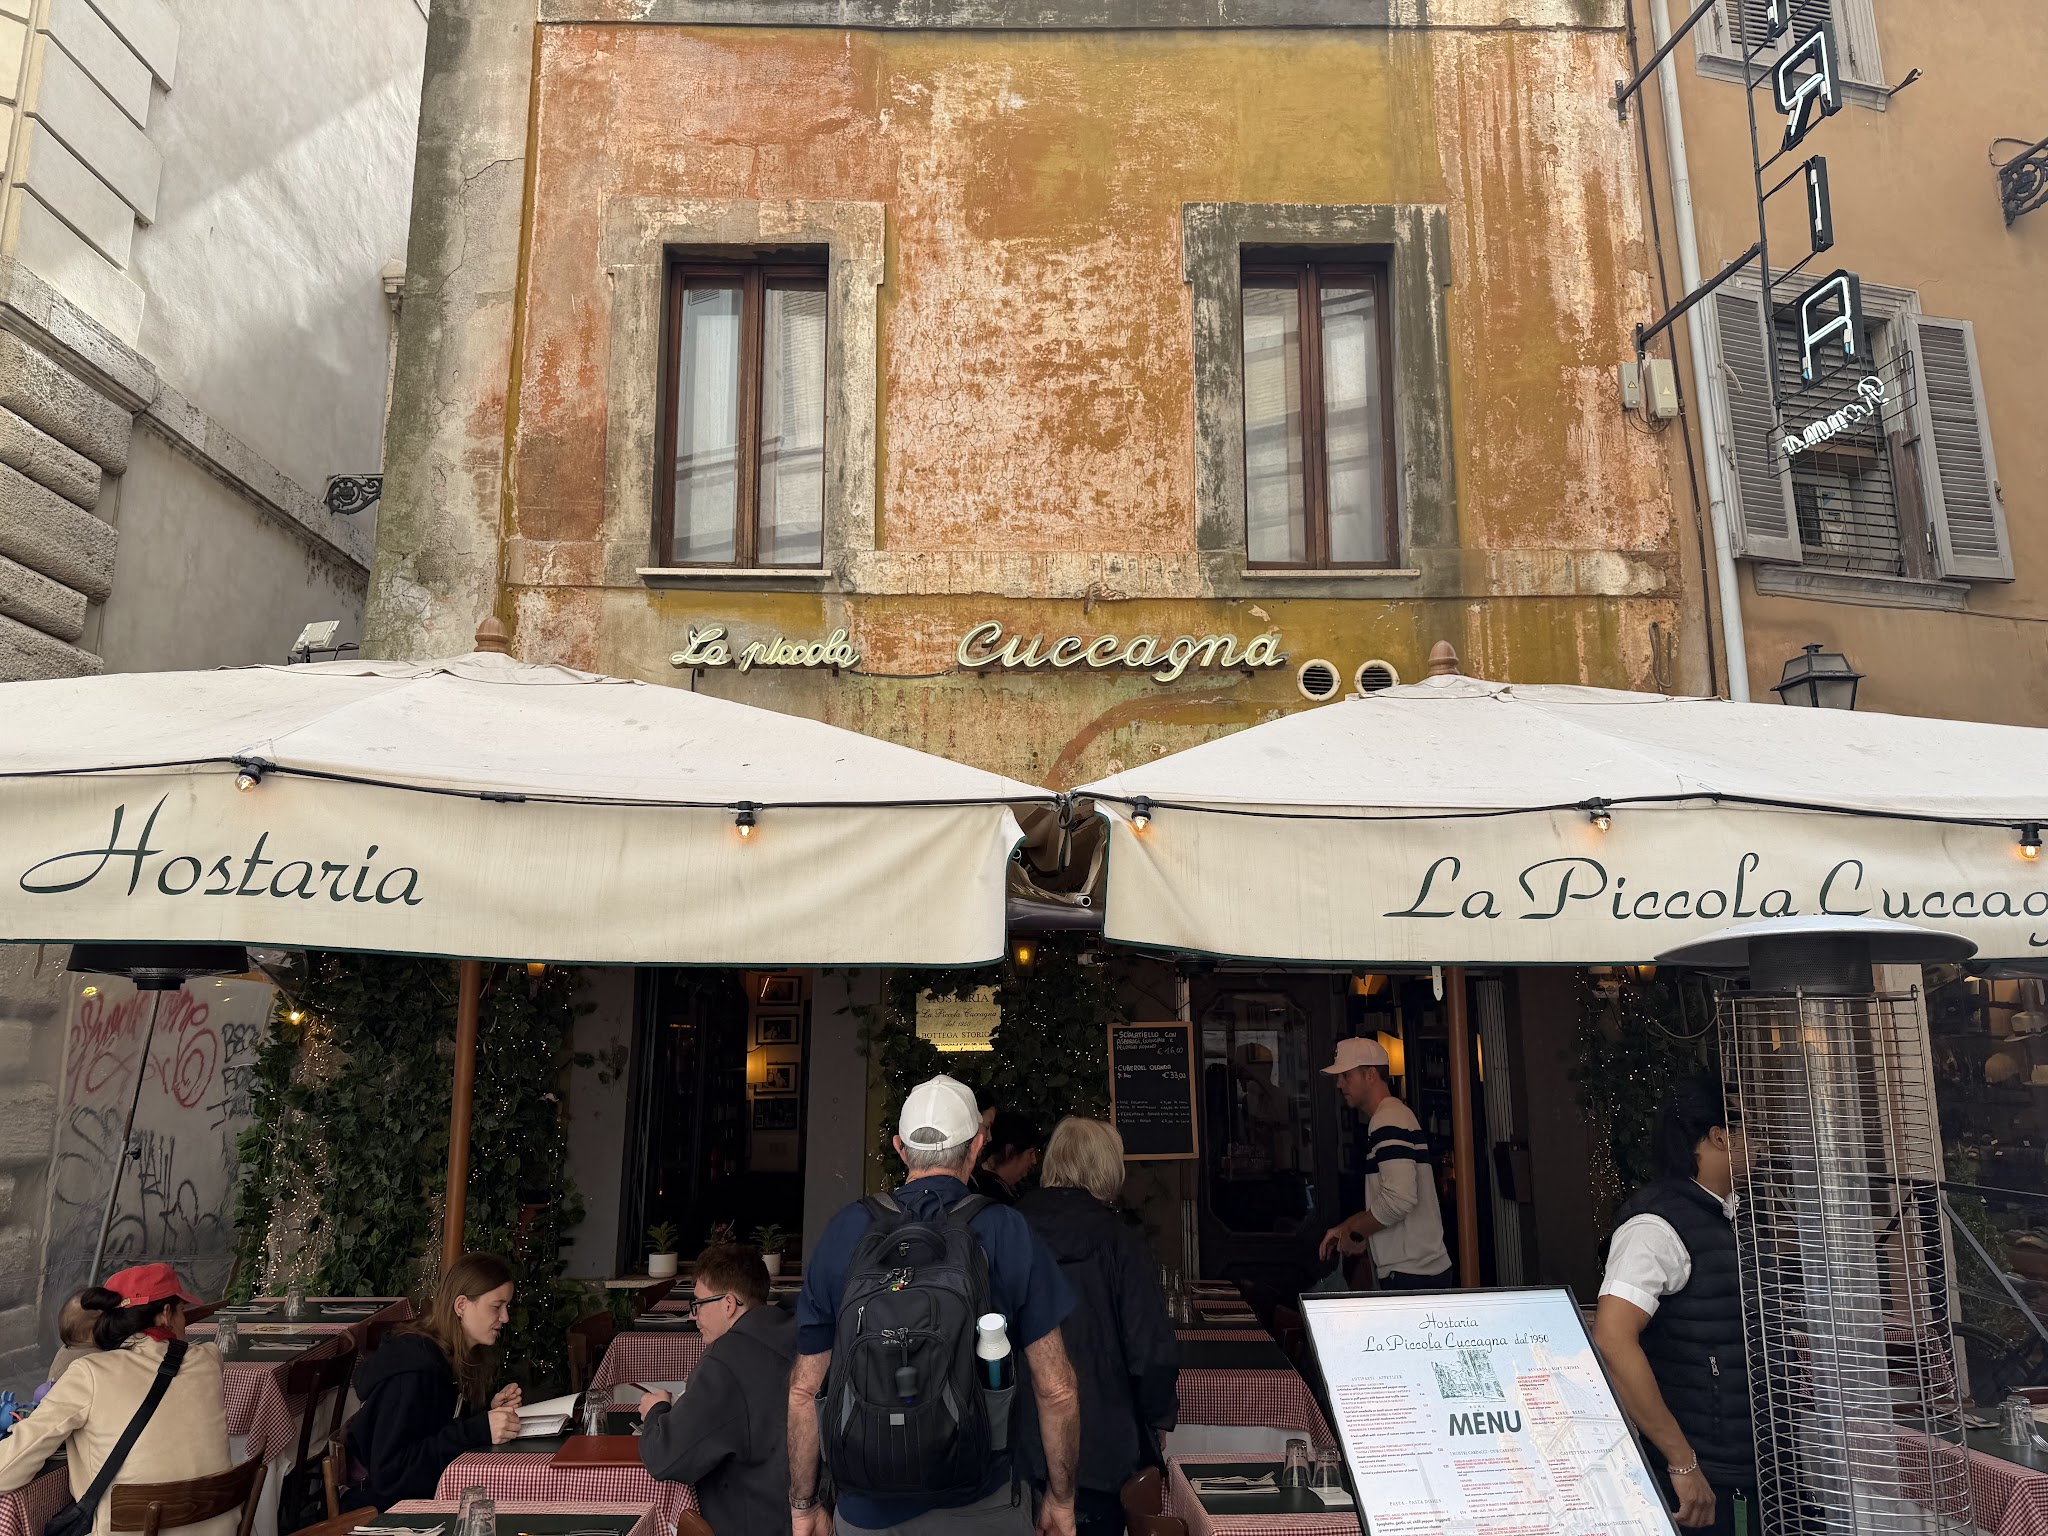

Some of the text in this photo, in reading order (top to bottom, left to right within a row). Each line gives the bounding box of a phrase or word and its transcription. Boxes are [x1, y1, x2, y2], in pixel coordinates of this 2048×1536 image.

[669, 619, 1289, 684] La piccola Cuccagna
[19, 791, 425, 906] Hostaria
[1382, 856, 1502, 919] La
[1519, 852, 1801, 919] Piccola
[1362, 1331, 1550, 1354] La Piccola Cuccagna dal 1950
[1418, 1312, 1479, 1330] Hostaria
[1449, 1410, 1522, 1437] MENU
